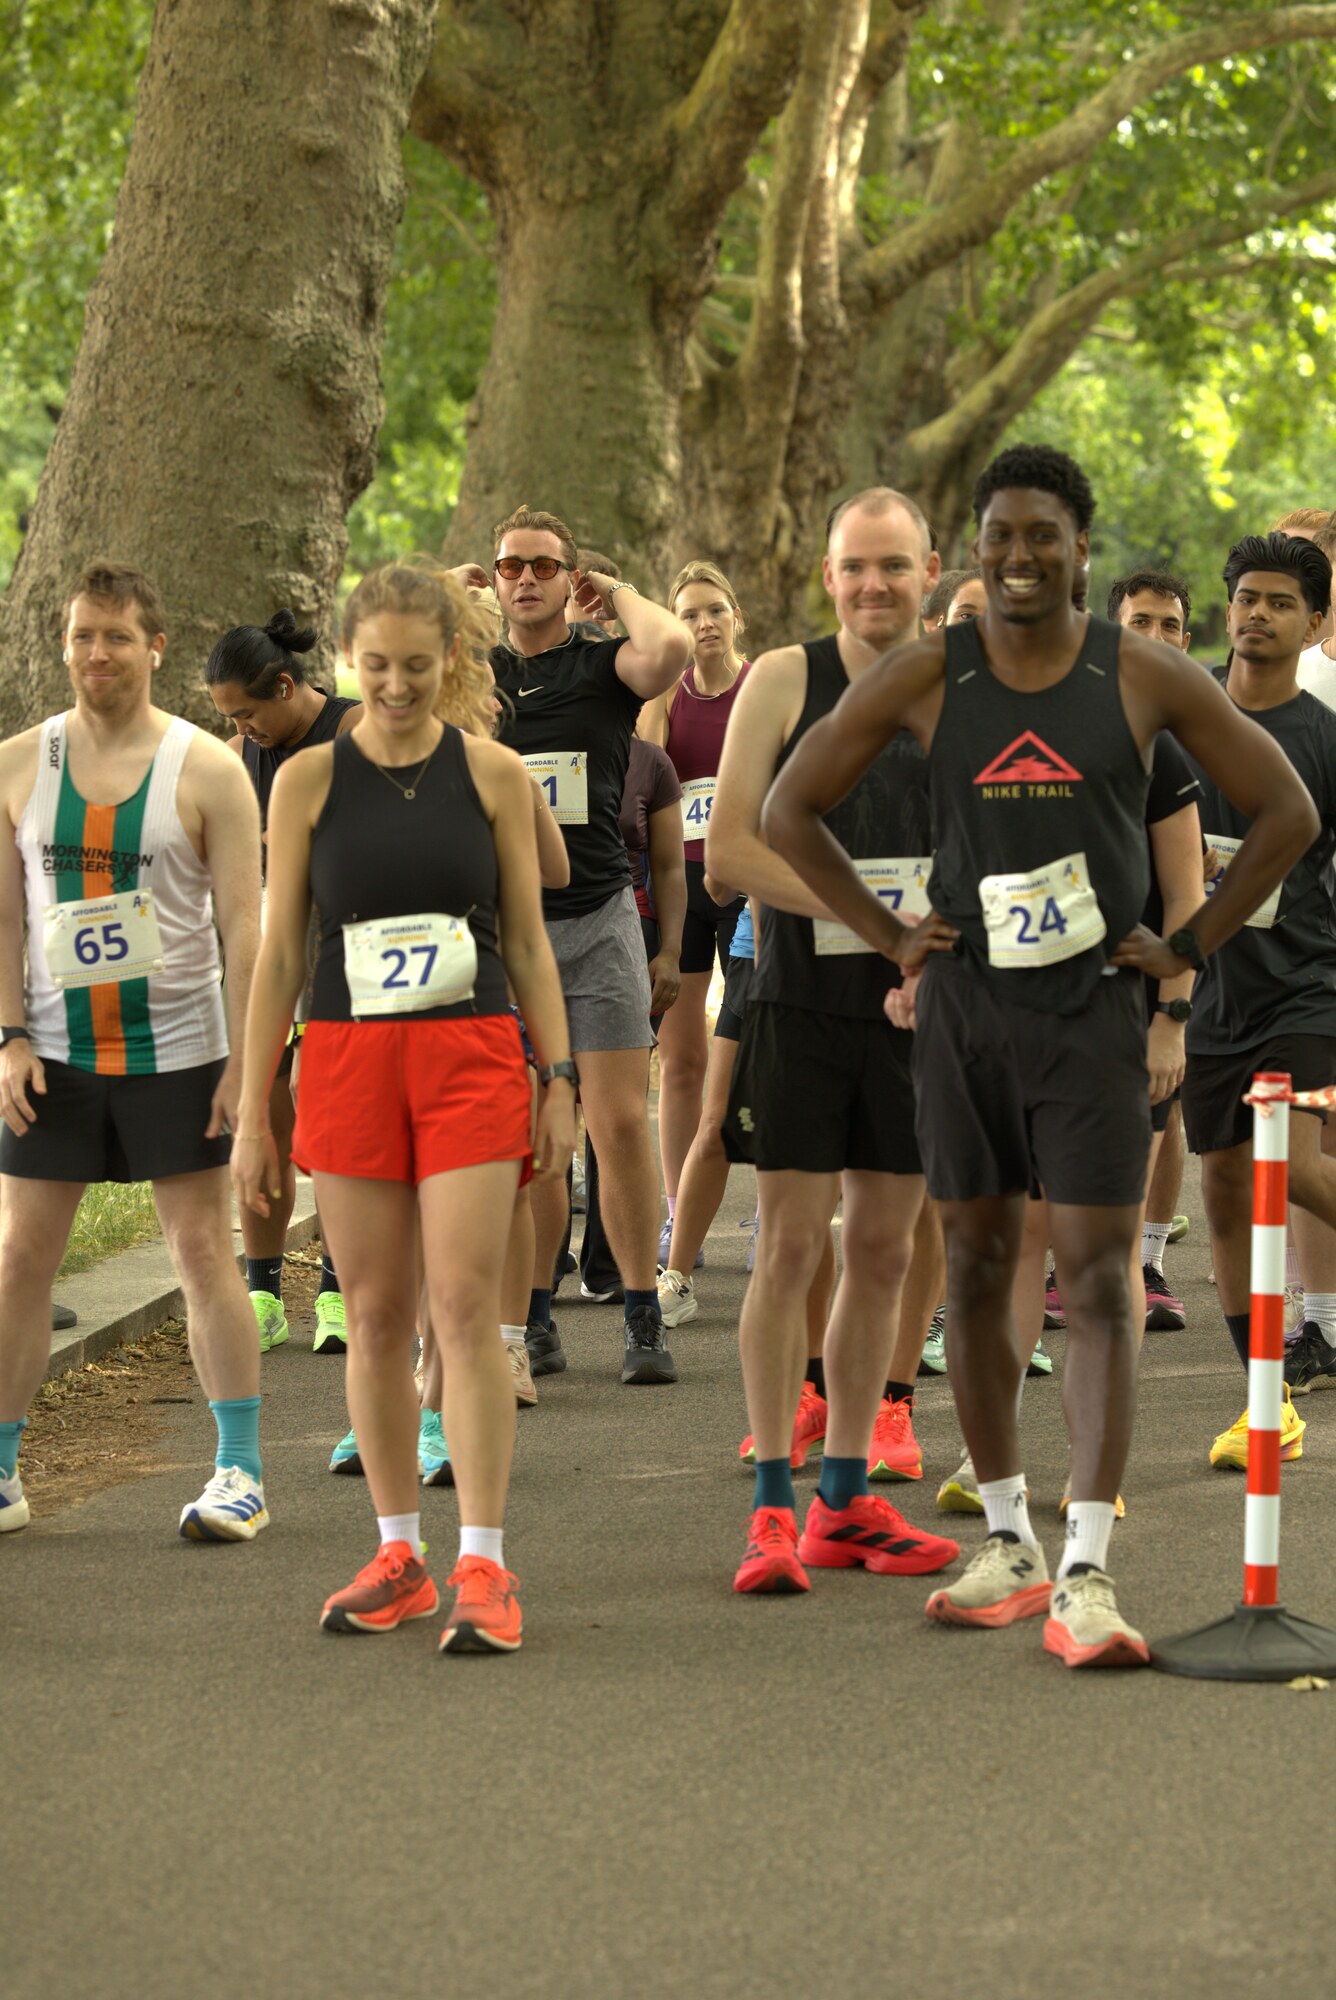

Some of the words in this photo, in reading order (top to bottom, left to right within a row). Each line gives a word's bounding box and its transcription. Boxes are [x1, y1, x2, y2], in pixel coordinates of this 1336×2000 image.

[50, 737, 60, 770] soar
[524, 759, 559, 767] FORDABLE
[527, 766, 555, 774] UNNING
[541, 775, 557, 807] 1
[689, 783, 717, 791] AFFORDABL
[982, 785, 1021, 799] NIKE
[1027, 784, 1074, 798] TRAIL
[42, 844, 154, 868] MORNINGTON
[42, 859, 117, 876] CHASERS
[877, 888, 904, 910] 7
[72, 904, 118, 918] AFFORDABLE
[1008, 896, 1068, 944] 24
[74, 922, 129, 966] 65
[381, 944, 439, 989] 27
